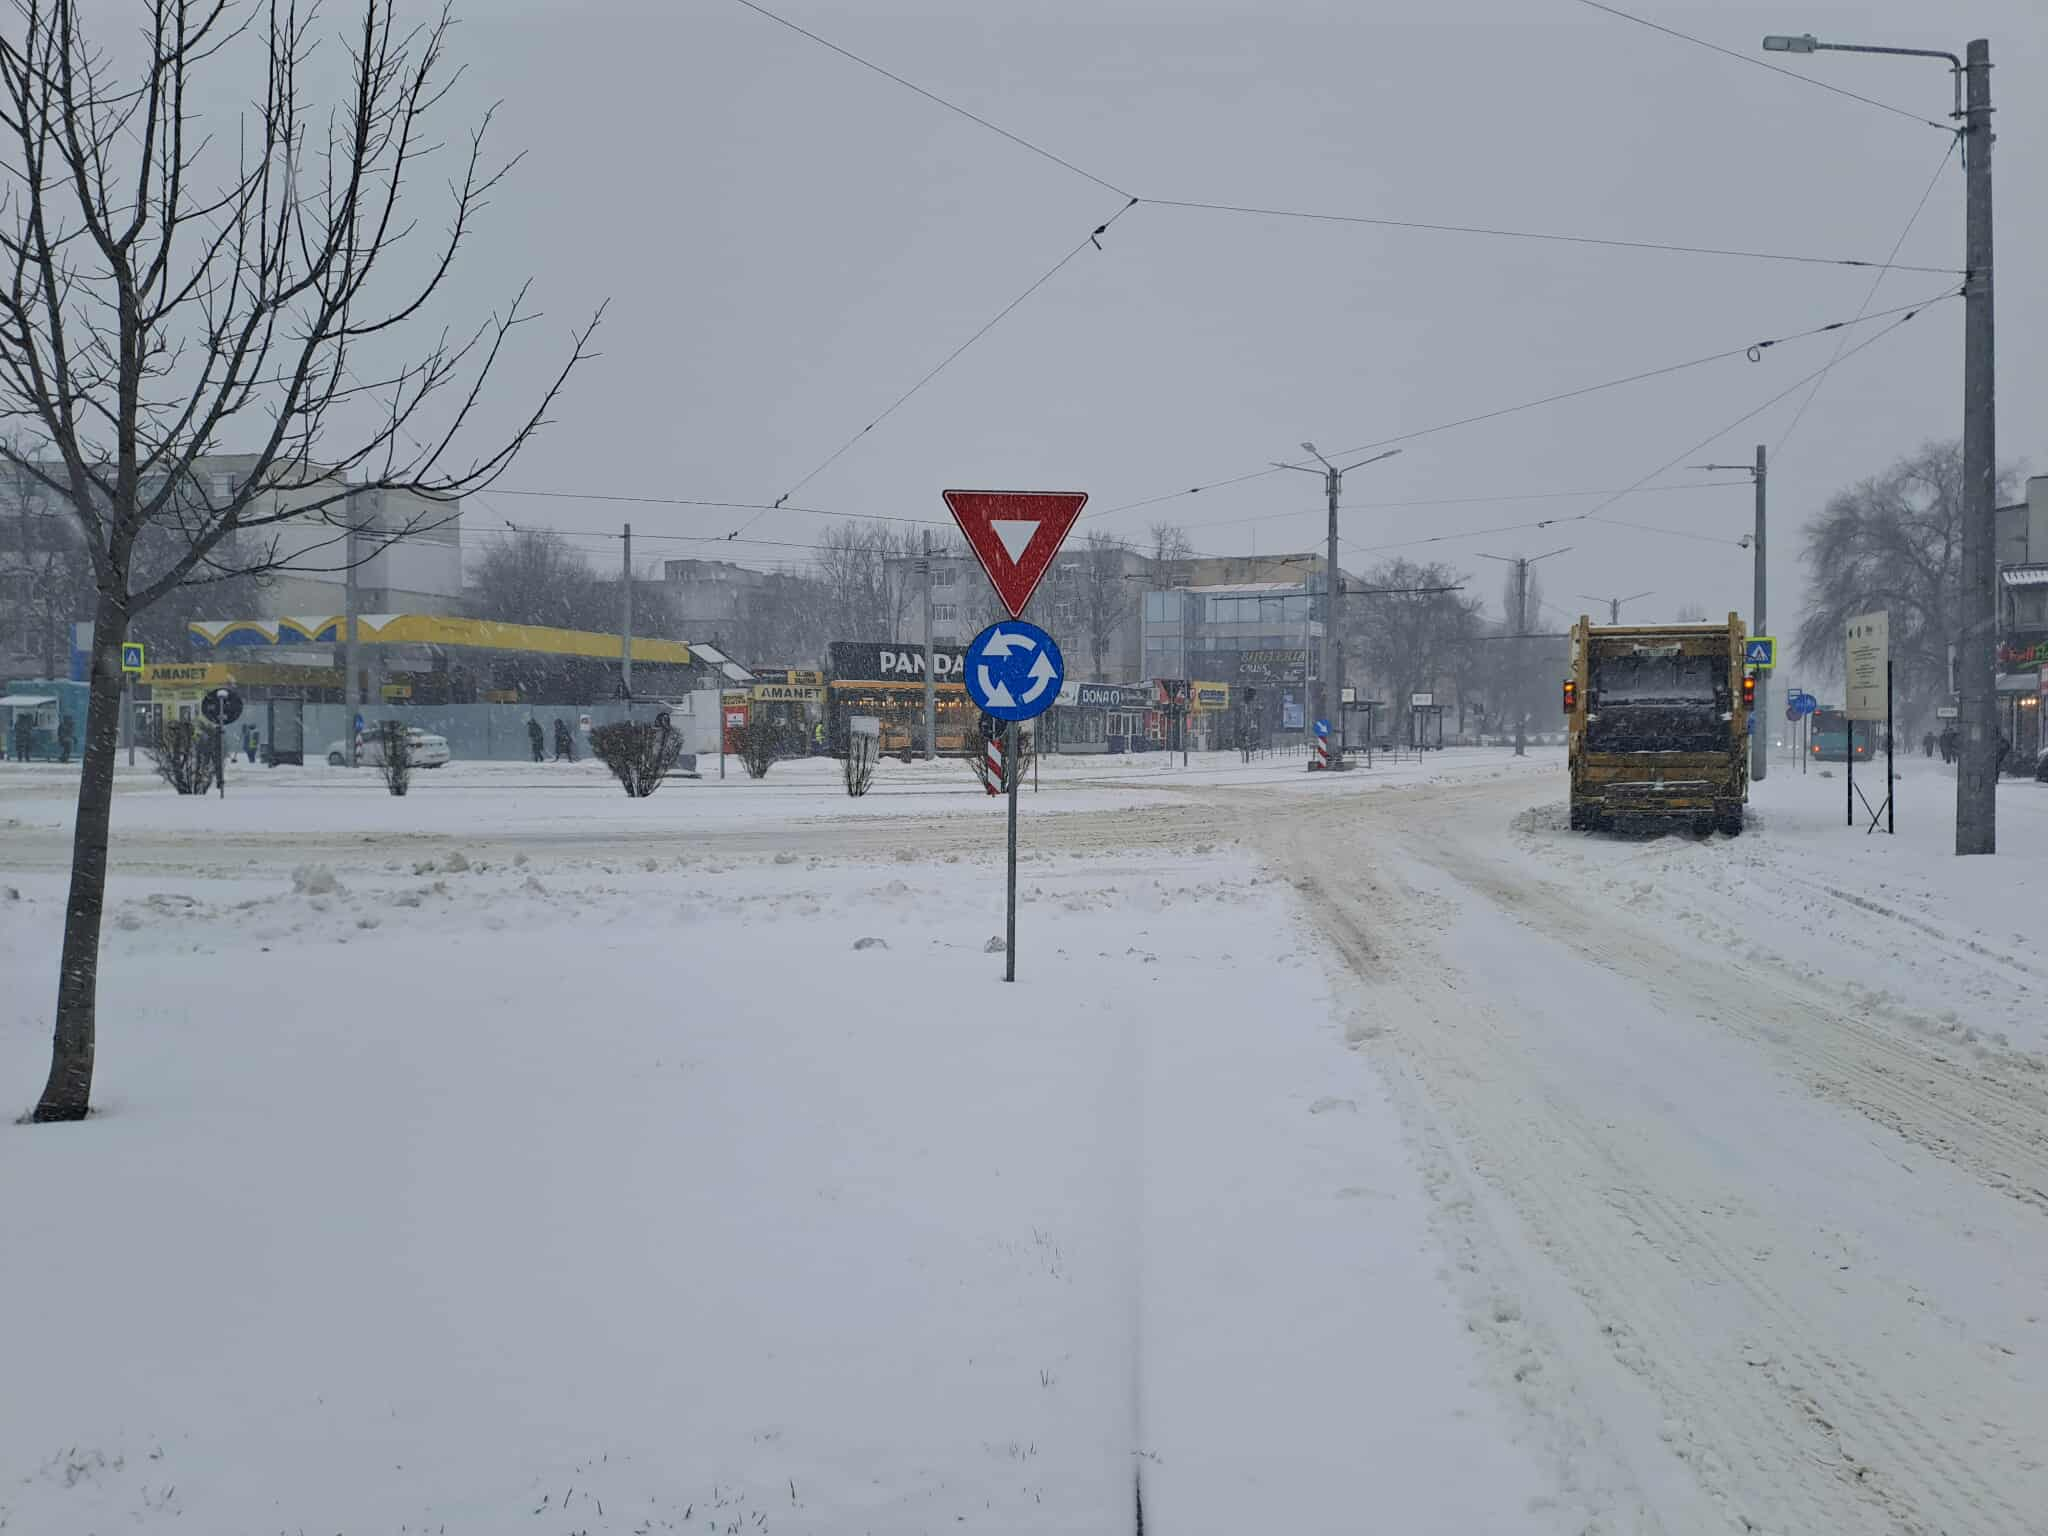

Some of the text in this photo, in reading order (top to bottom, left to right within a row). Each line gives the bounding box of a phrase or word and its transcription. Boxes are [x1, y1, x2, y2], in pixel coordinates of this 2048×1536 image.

[879, 651, 964, 674] PANDA
[152, 668, 208, 680] AMANET
[761, 687, 822, 699] AMANET
